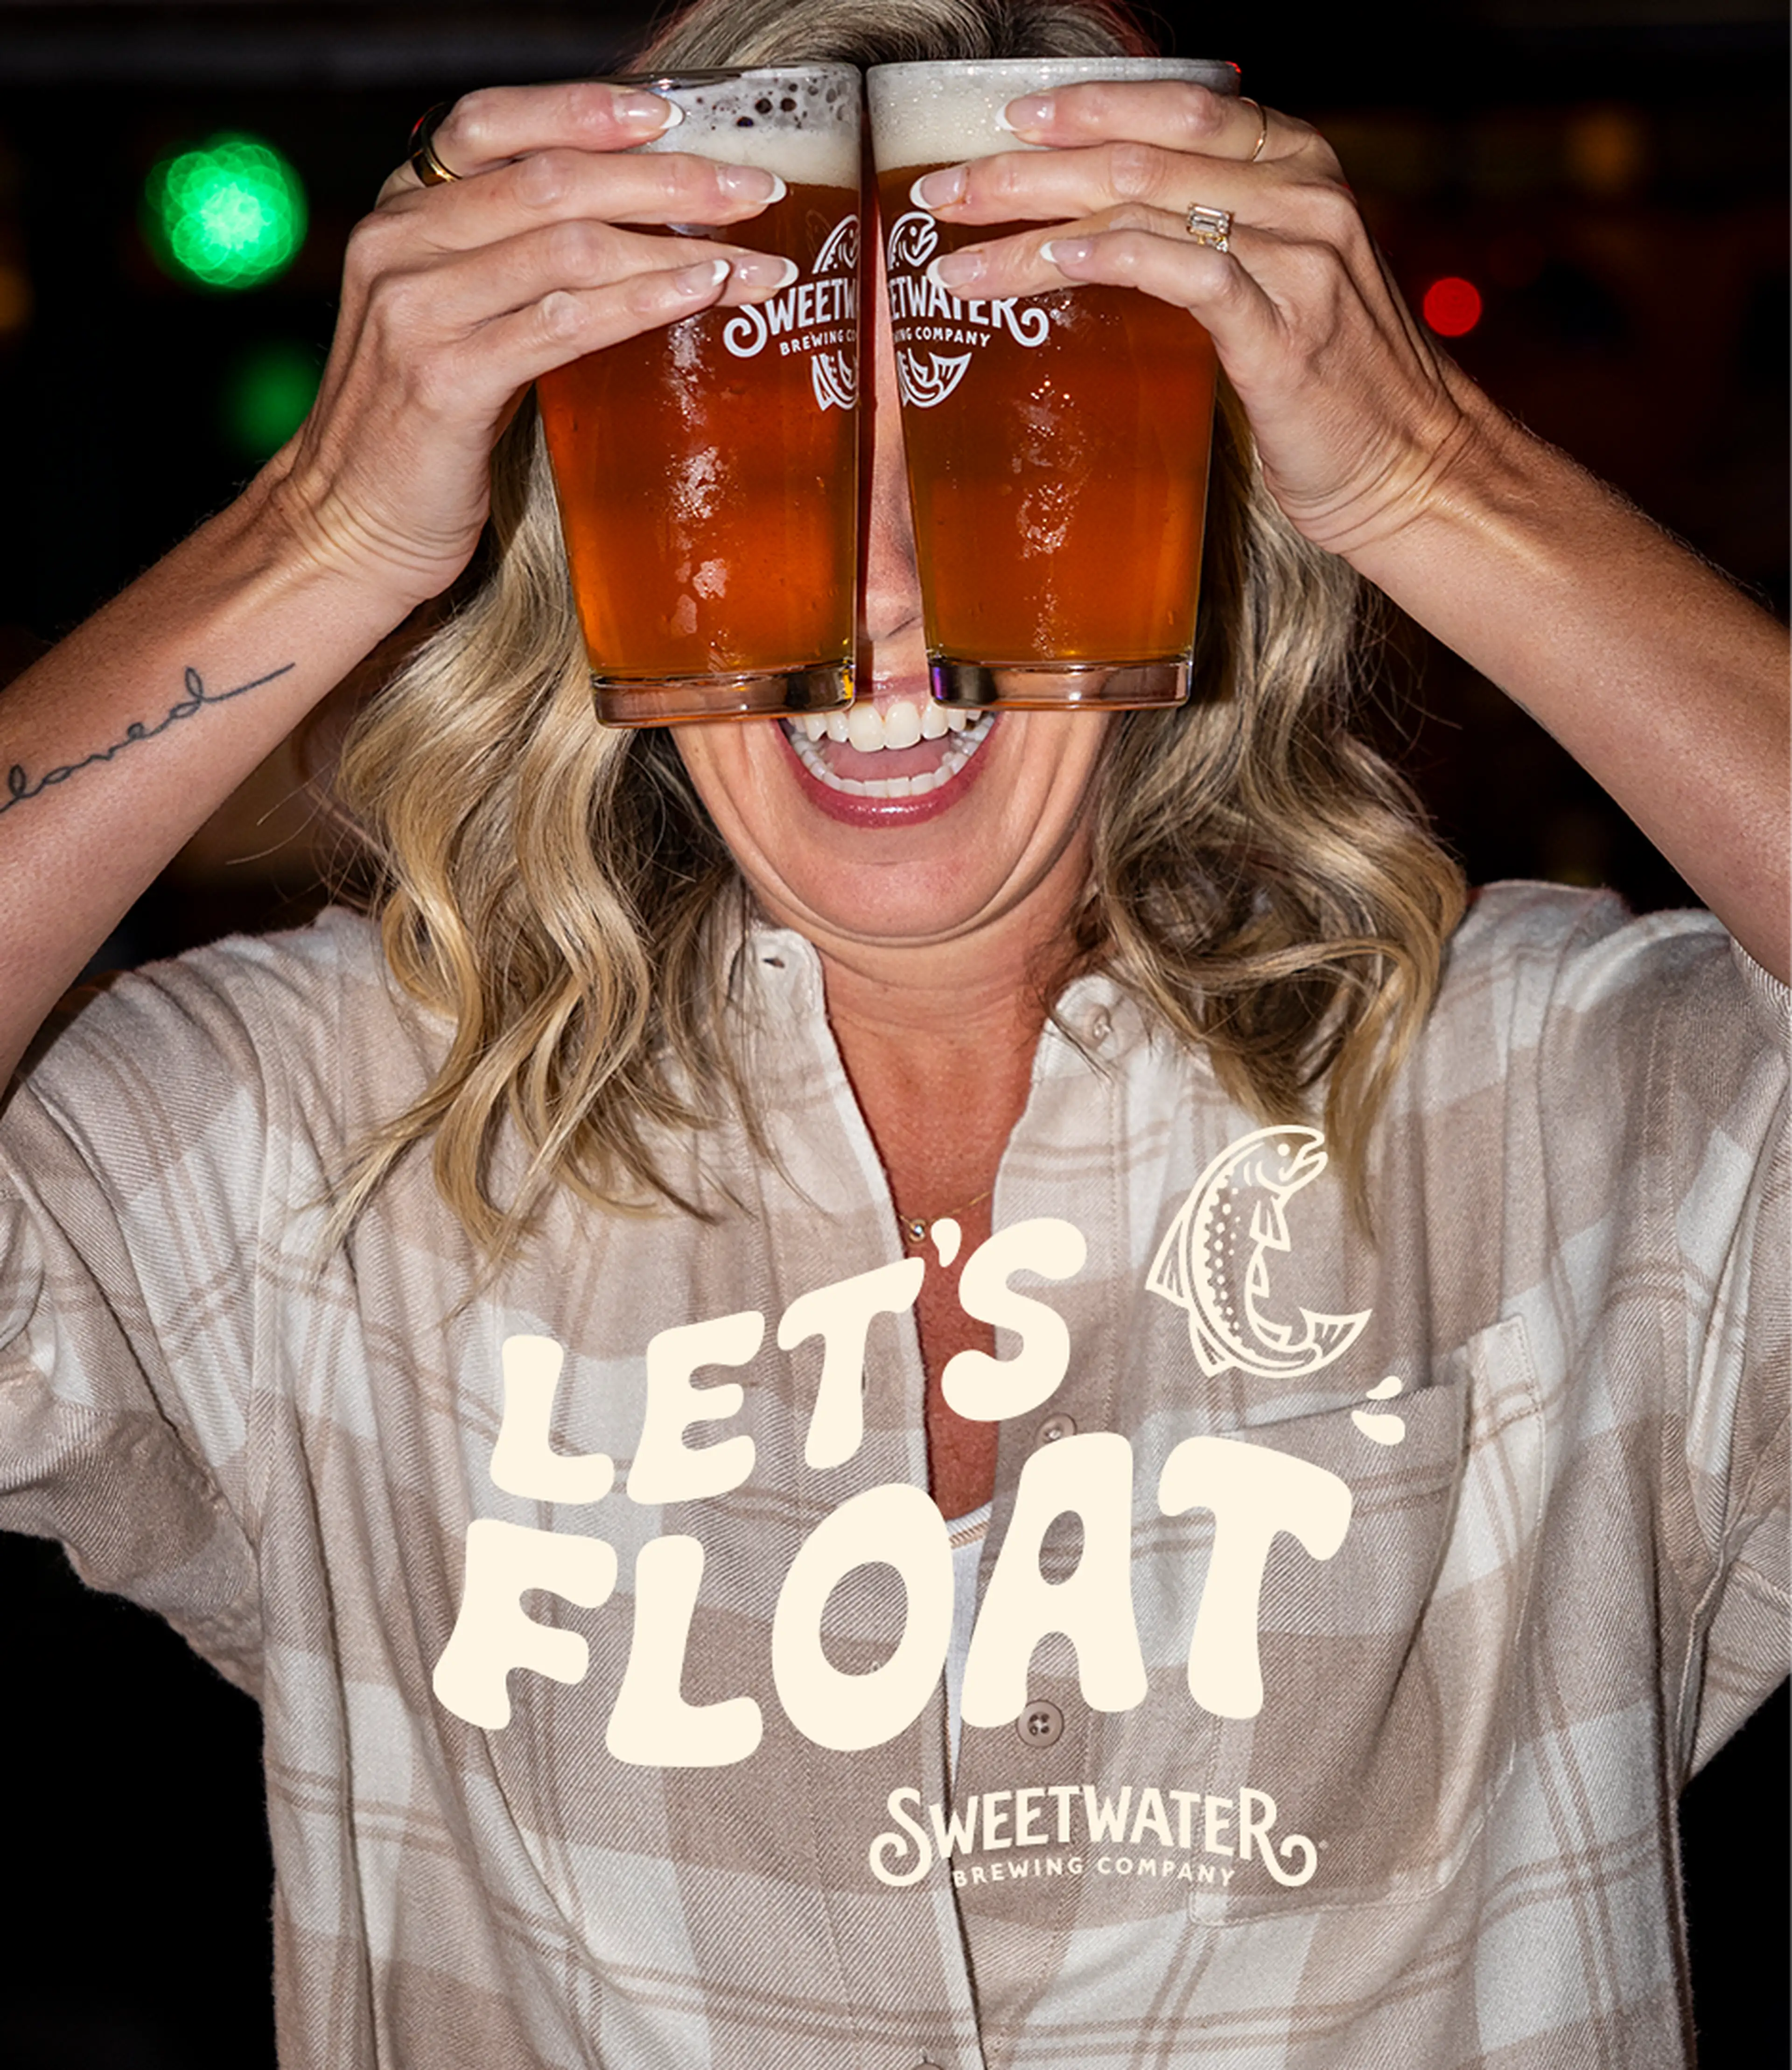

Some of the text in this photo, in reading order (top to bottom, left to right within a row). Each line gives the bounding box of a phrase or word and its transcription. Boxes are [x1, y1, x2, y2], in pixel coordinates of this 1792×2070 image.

[779, 329, 844, 357] BREWING
[914, 327, 991, 348] COMPANY
[0, 662, 296, 814] loved
